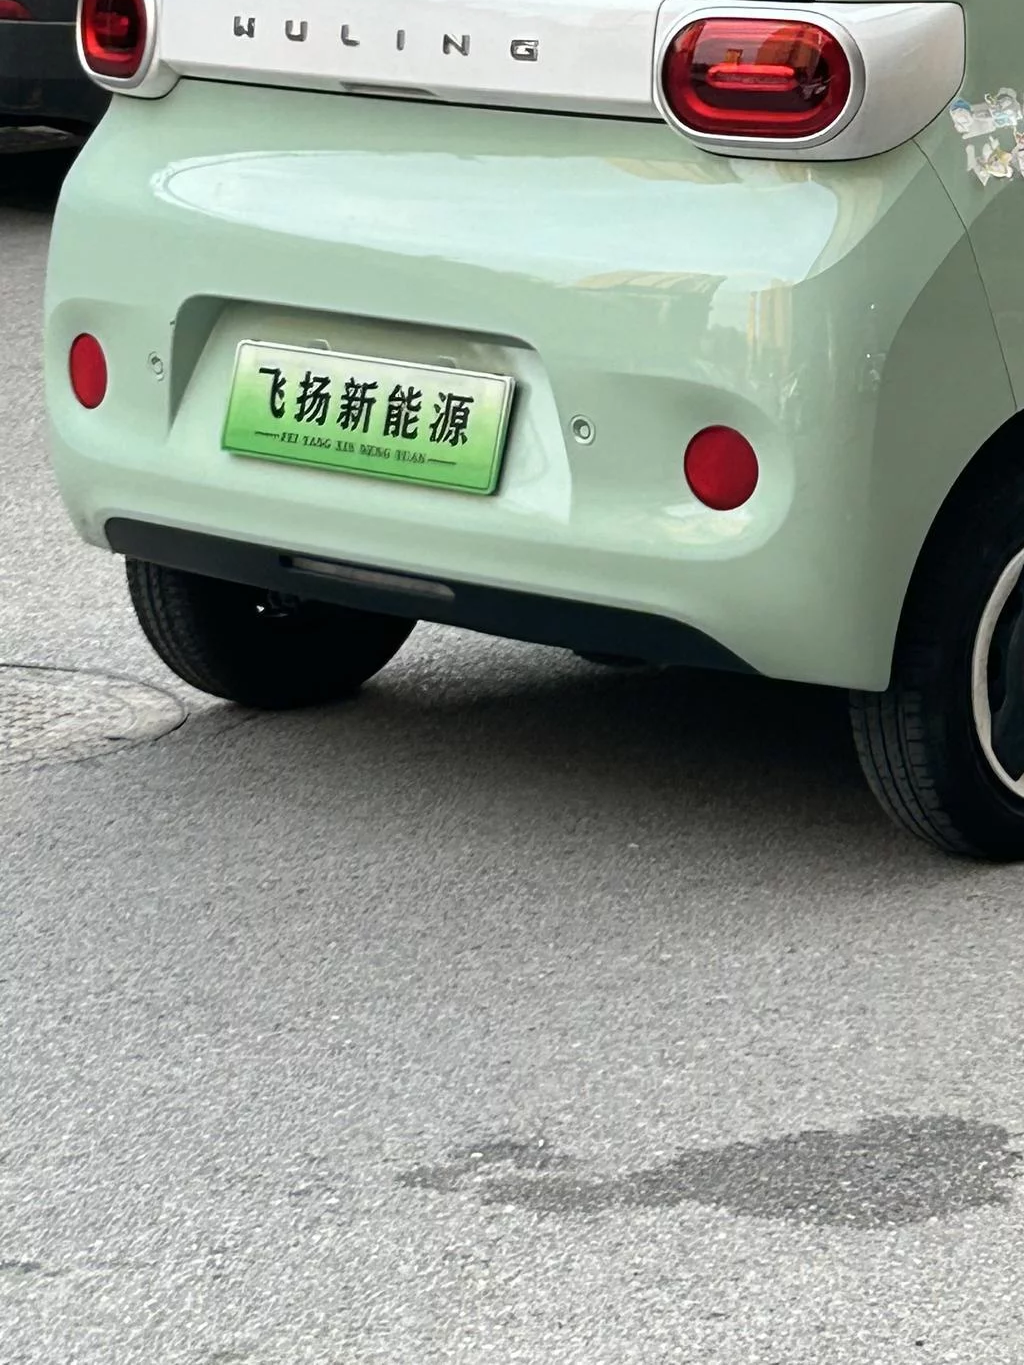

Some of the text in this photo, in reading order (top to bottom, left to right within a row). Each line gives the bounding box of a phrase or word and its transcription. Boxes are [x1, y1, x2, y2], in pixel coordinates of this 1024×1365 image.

[233, 16, 539, 61] WULING
[259, 368, 474, 447] 飞扬新能源
